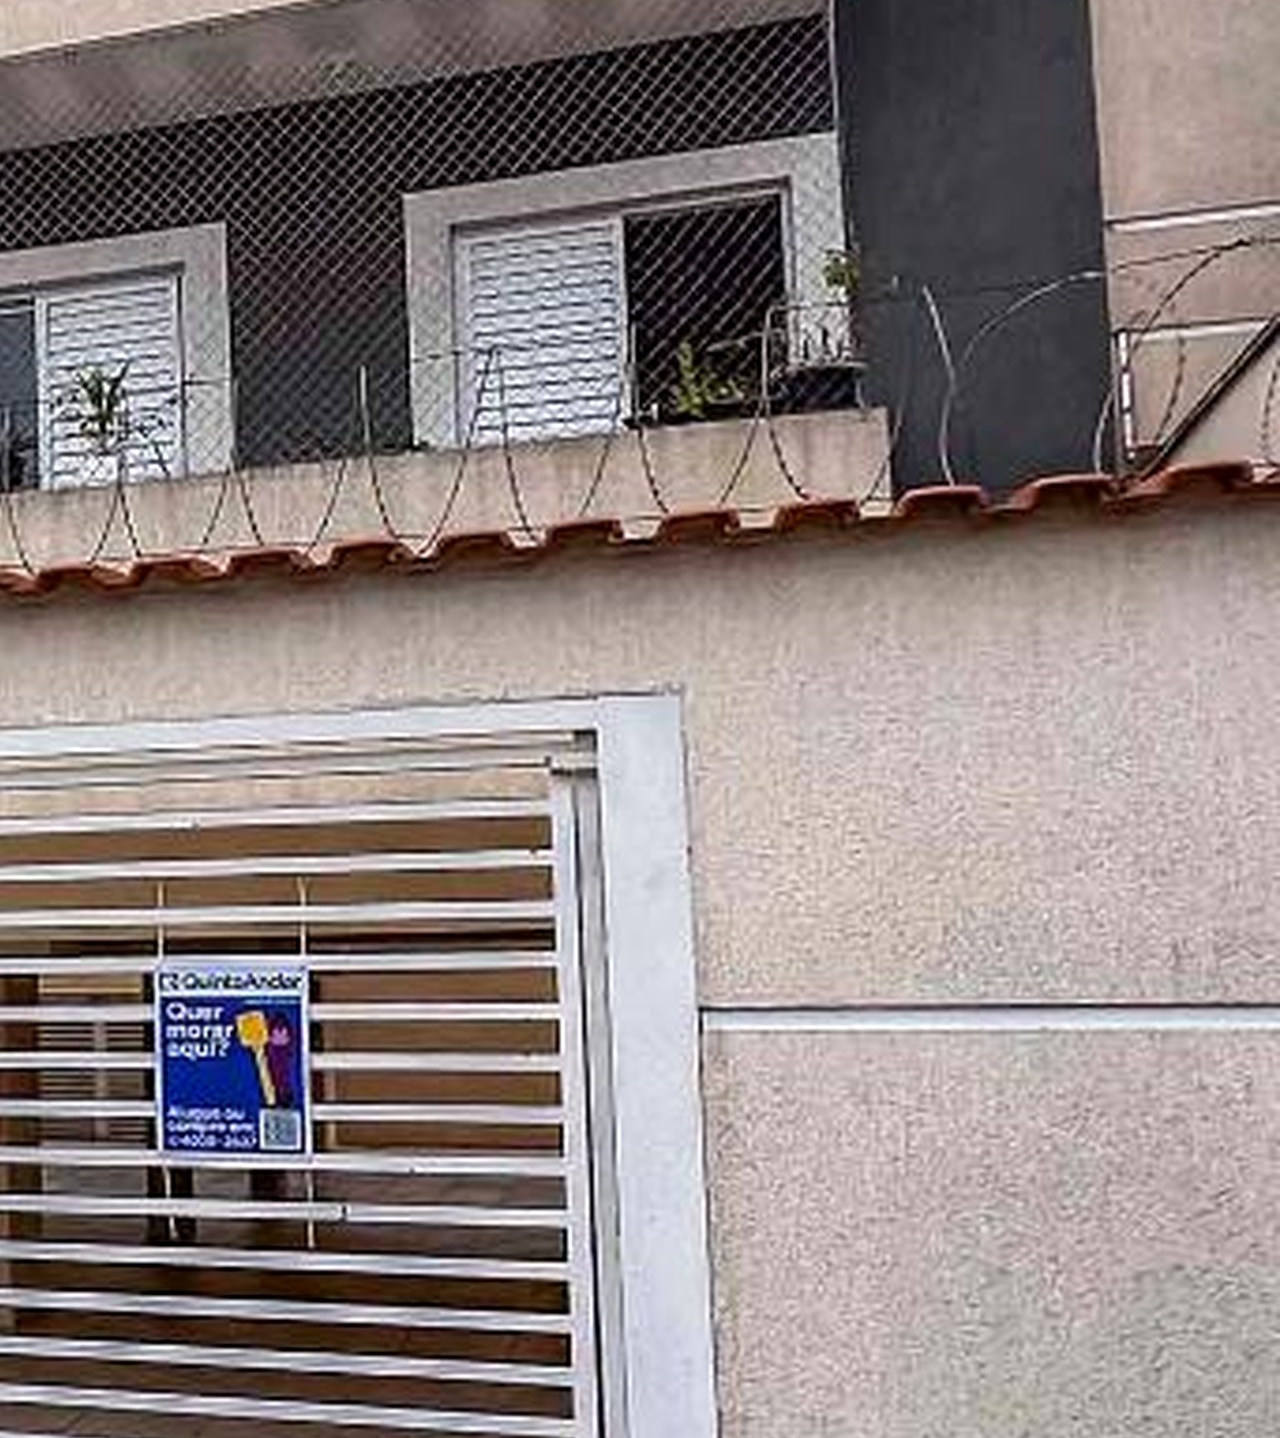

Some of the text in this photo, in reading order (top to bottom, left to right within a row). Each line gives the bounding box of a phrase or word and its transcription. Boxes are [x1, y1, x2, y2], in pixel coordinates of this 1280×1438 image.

[181, 973, 302, 990] QuintoAndar
[165, 1002, 224, 1021] Quer
[165, 1023, 235, 1039] morar
[166, 1040, 231, 1060] aqui?
